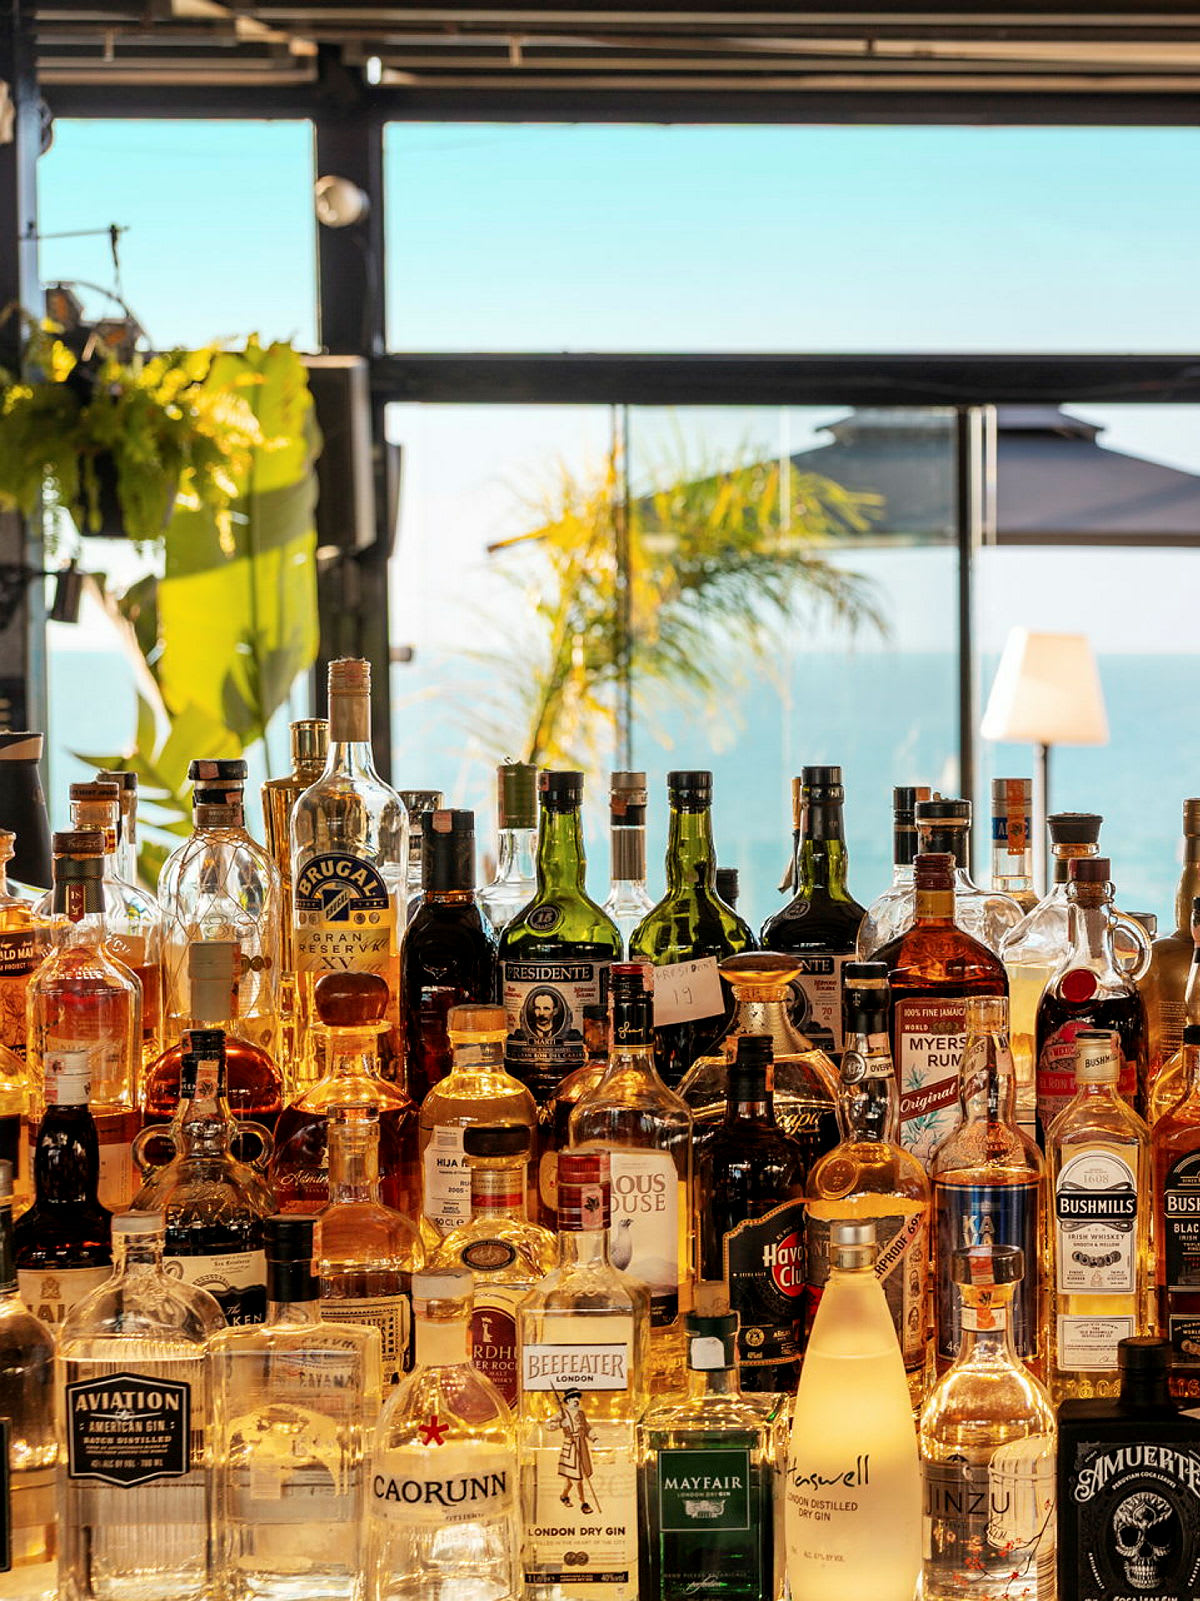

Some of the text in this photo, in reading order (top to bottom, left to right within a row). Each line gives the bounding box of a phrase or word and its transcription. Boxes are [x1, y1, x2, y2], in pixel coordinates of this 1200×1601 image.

[299, 860, 376, 897] BRUGAL
[313, 933, 362, 942] GRAN
[299, 944, 380, 954] RESERVA
[321, 957, 354, 970] XV
[507, 966, 590, 980] PRESIDENTE
[922, 1008, 939, 1017] FINE
[940, 1007, 967, 1018] JAMAIC
[909, 1037, 968, 1051] MYERS
[900, 1081, 957, 1113] Original
[437, 1158, 458, 1167] HIJA
[281, 1171, 329, 1186] Admir
[1060, 1198, 1134, 1213] BUSHMILLS
[781, 1266, 803, 1287] Clu
[233, 1313, 263, 1325] KEN
[492, 1361, 516, 1370] ROC
[528, 1354, 625, 1379] BEEFEATER
[75, 1391, 180, 1411] AVIATION
[89, 1421, 143, 1432] AMERICAN
[1141, 1471, 1157, 1479] COCA
[373, 1472, 506, 1506] CAORUNN
[664, 1477, 743, 1489] MAYFAIR
[927, 1481, 1010, 1515] JINZU
[811, 1499, 858, 1511] DISTILLED
[798, 1508, 831, 1521] DRY GIN
[528, 1526, 626, 1536] LONDON DRY GIN
